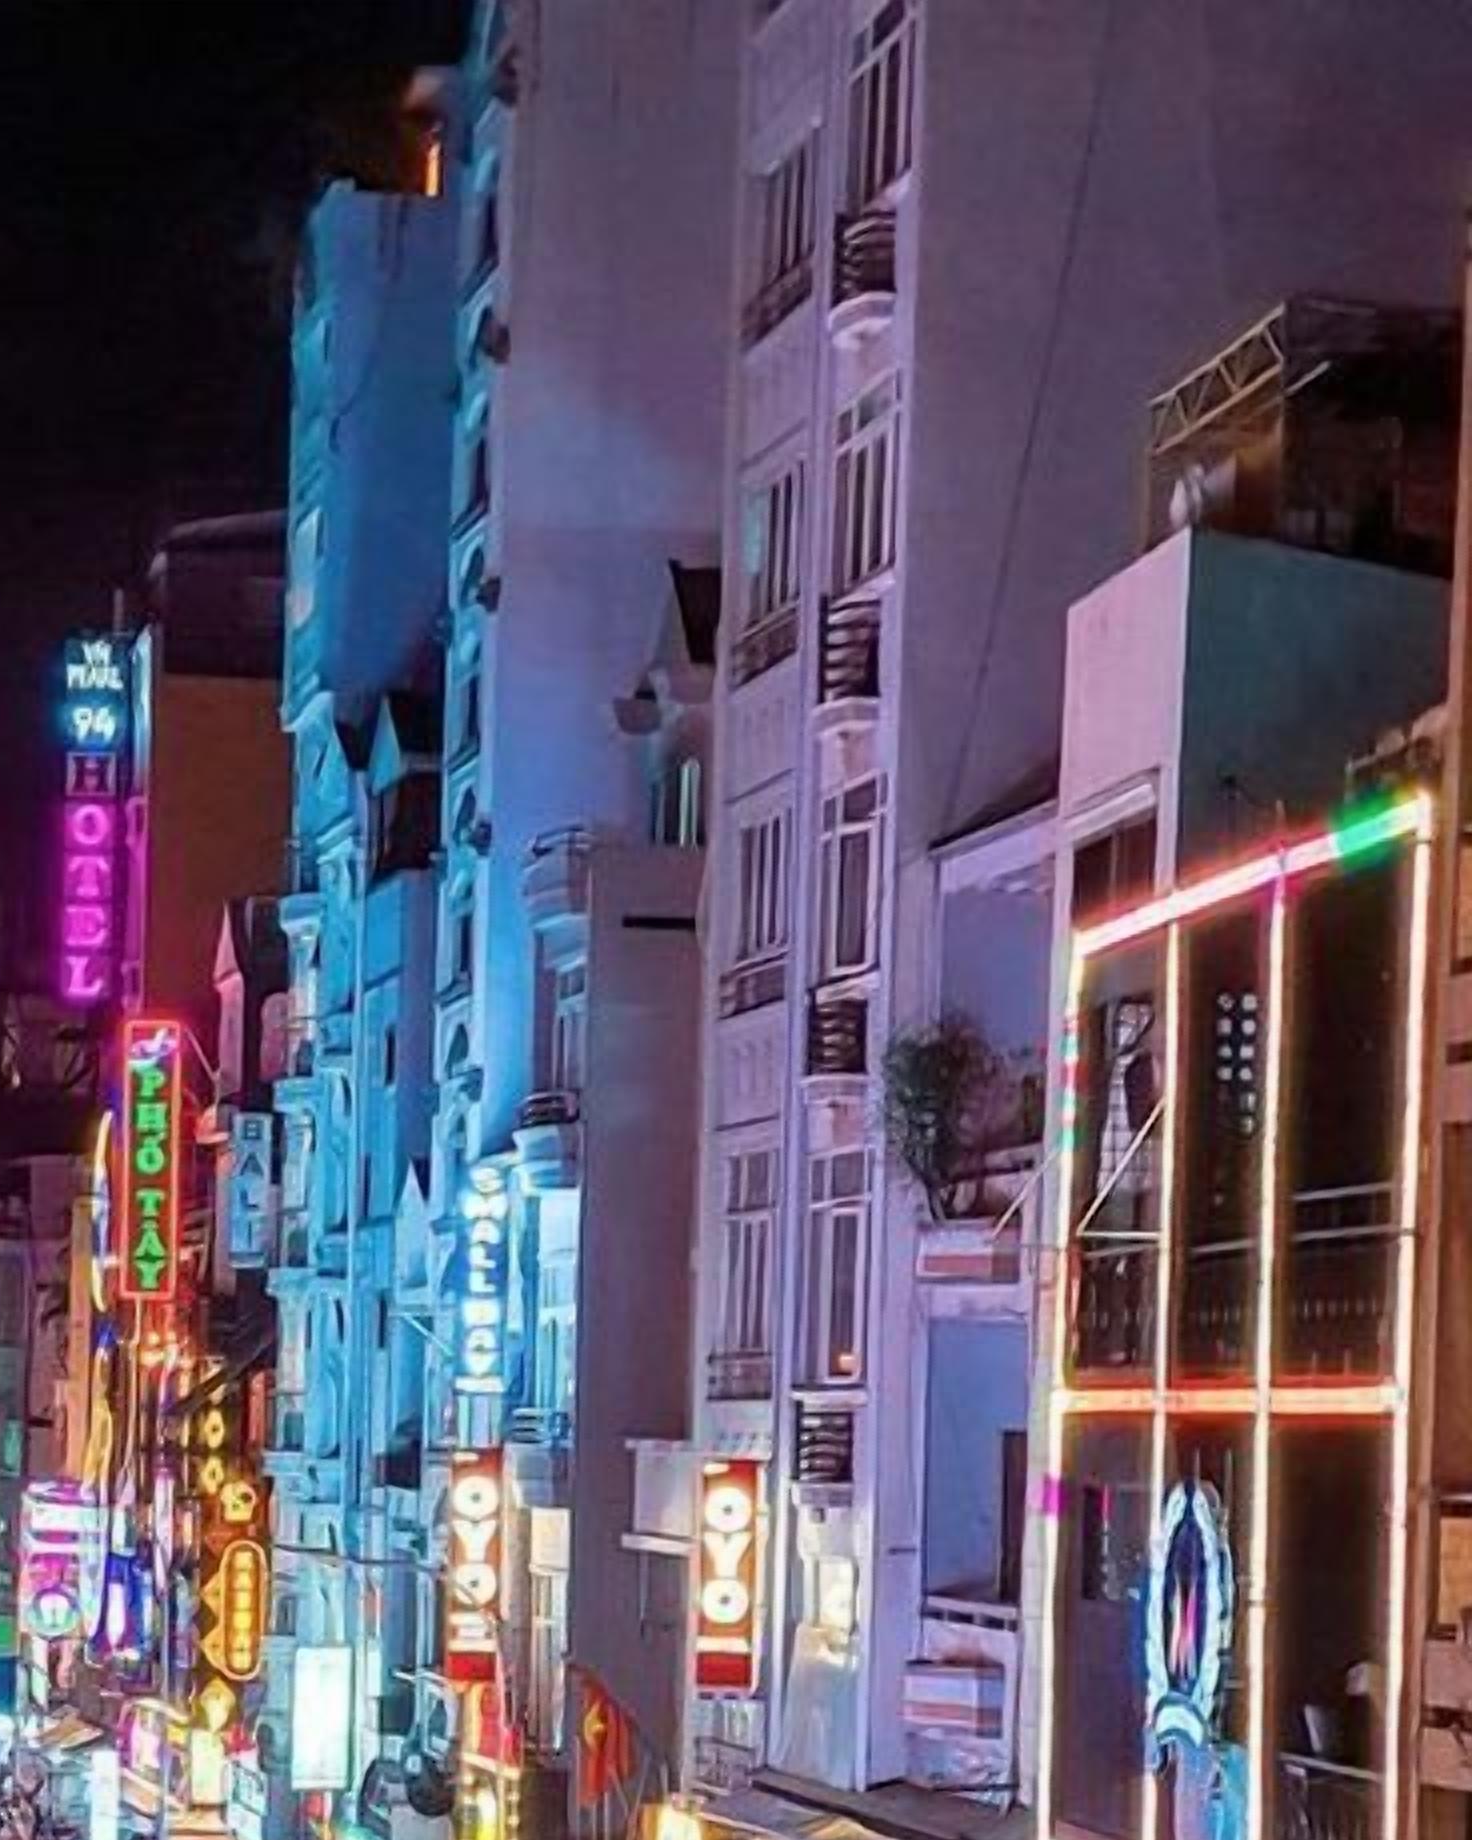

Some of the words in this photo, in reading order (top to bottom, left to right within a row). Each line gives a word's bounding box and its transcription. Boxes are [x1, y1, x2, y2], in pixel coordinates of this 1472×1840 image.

[73, 706, 116, 744] 94
[65, 752, 116, 996] HOTEL
[451, 1476, 500, 1609] OYO
[702, 1487, 752, 1624] OYO
